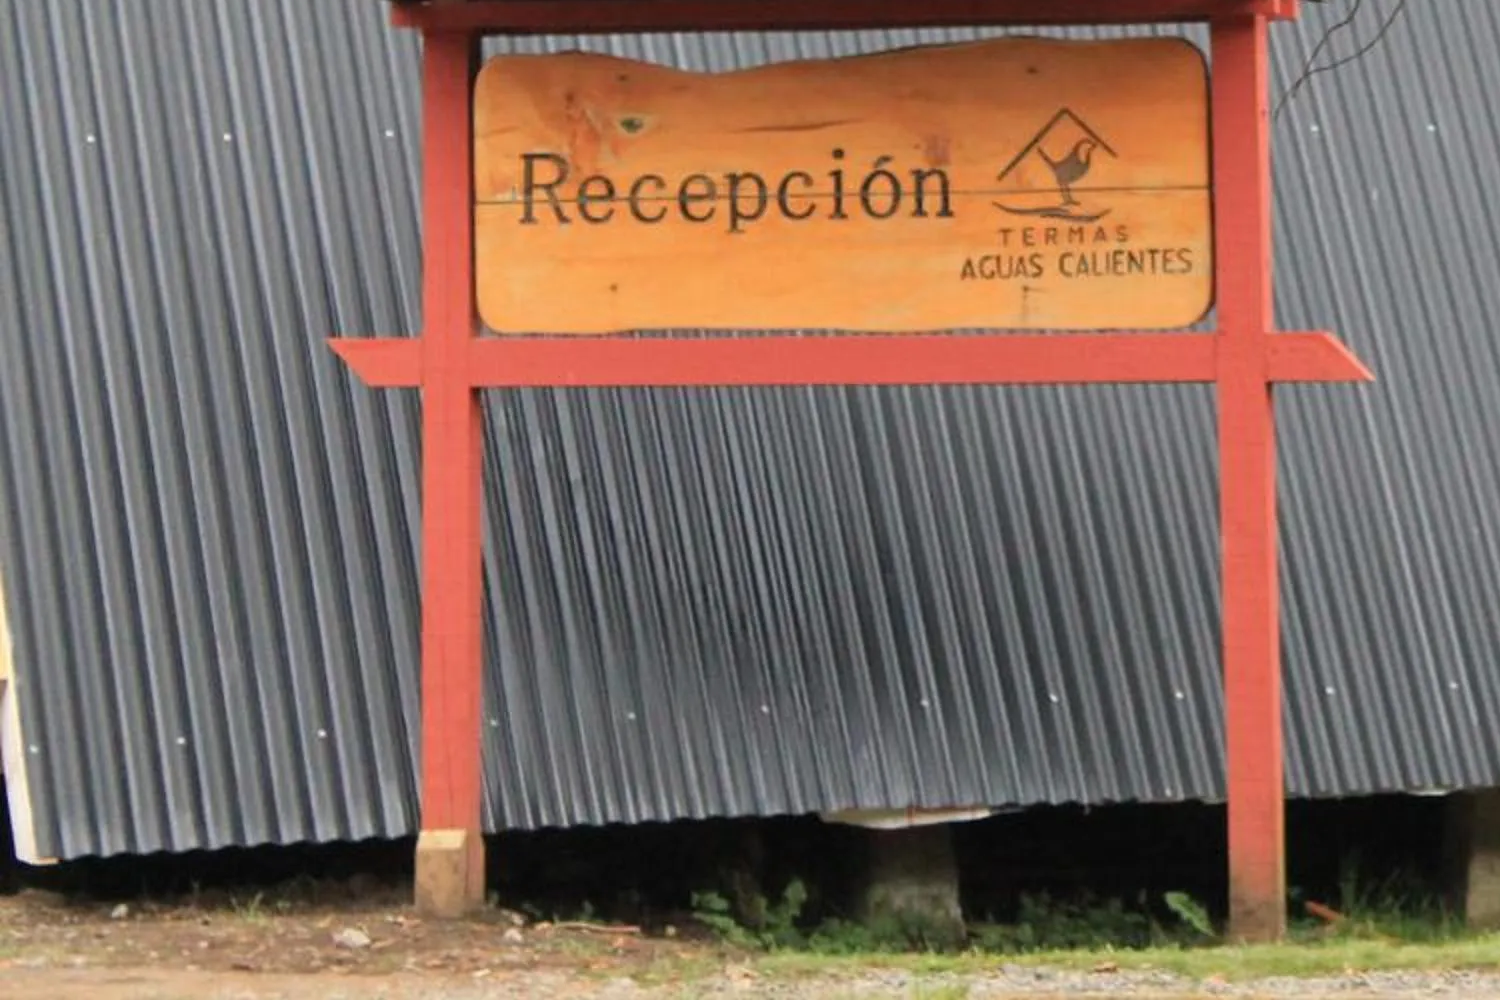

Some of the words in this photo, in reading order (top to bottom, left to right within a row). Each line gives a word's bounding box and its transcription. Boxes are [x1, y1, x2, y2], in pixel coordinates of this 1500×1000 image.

[518, 147, 955, 233] Recepción
[1000, 226, 1130, 246] TERMAS
[960, 254, 1043, 281] AGUAS
[1058, 248, 1193, 278] CALIENTES
